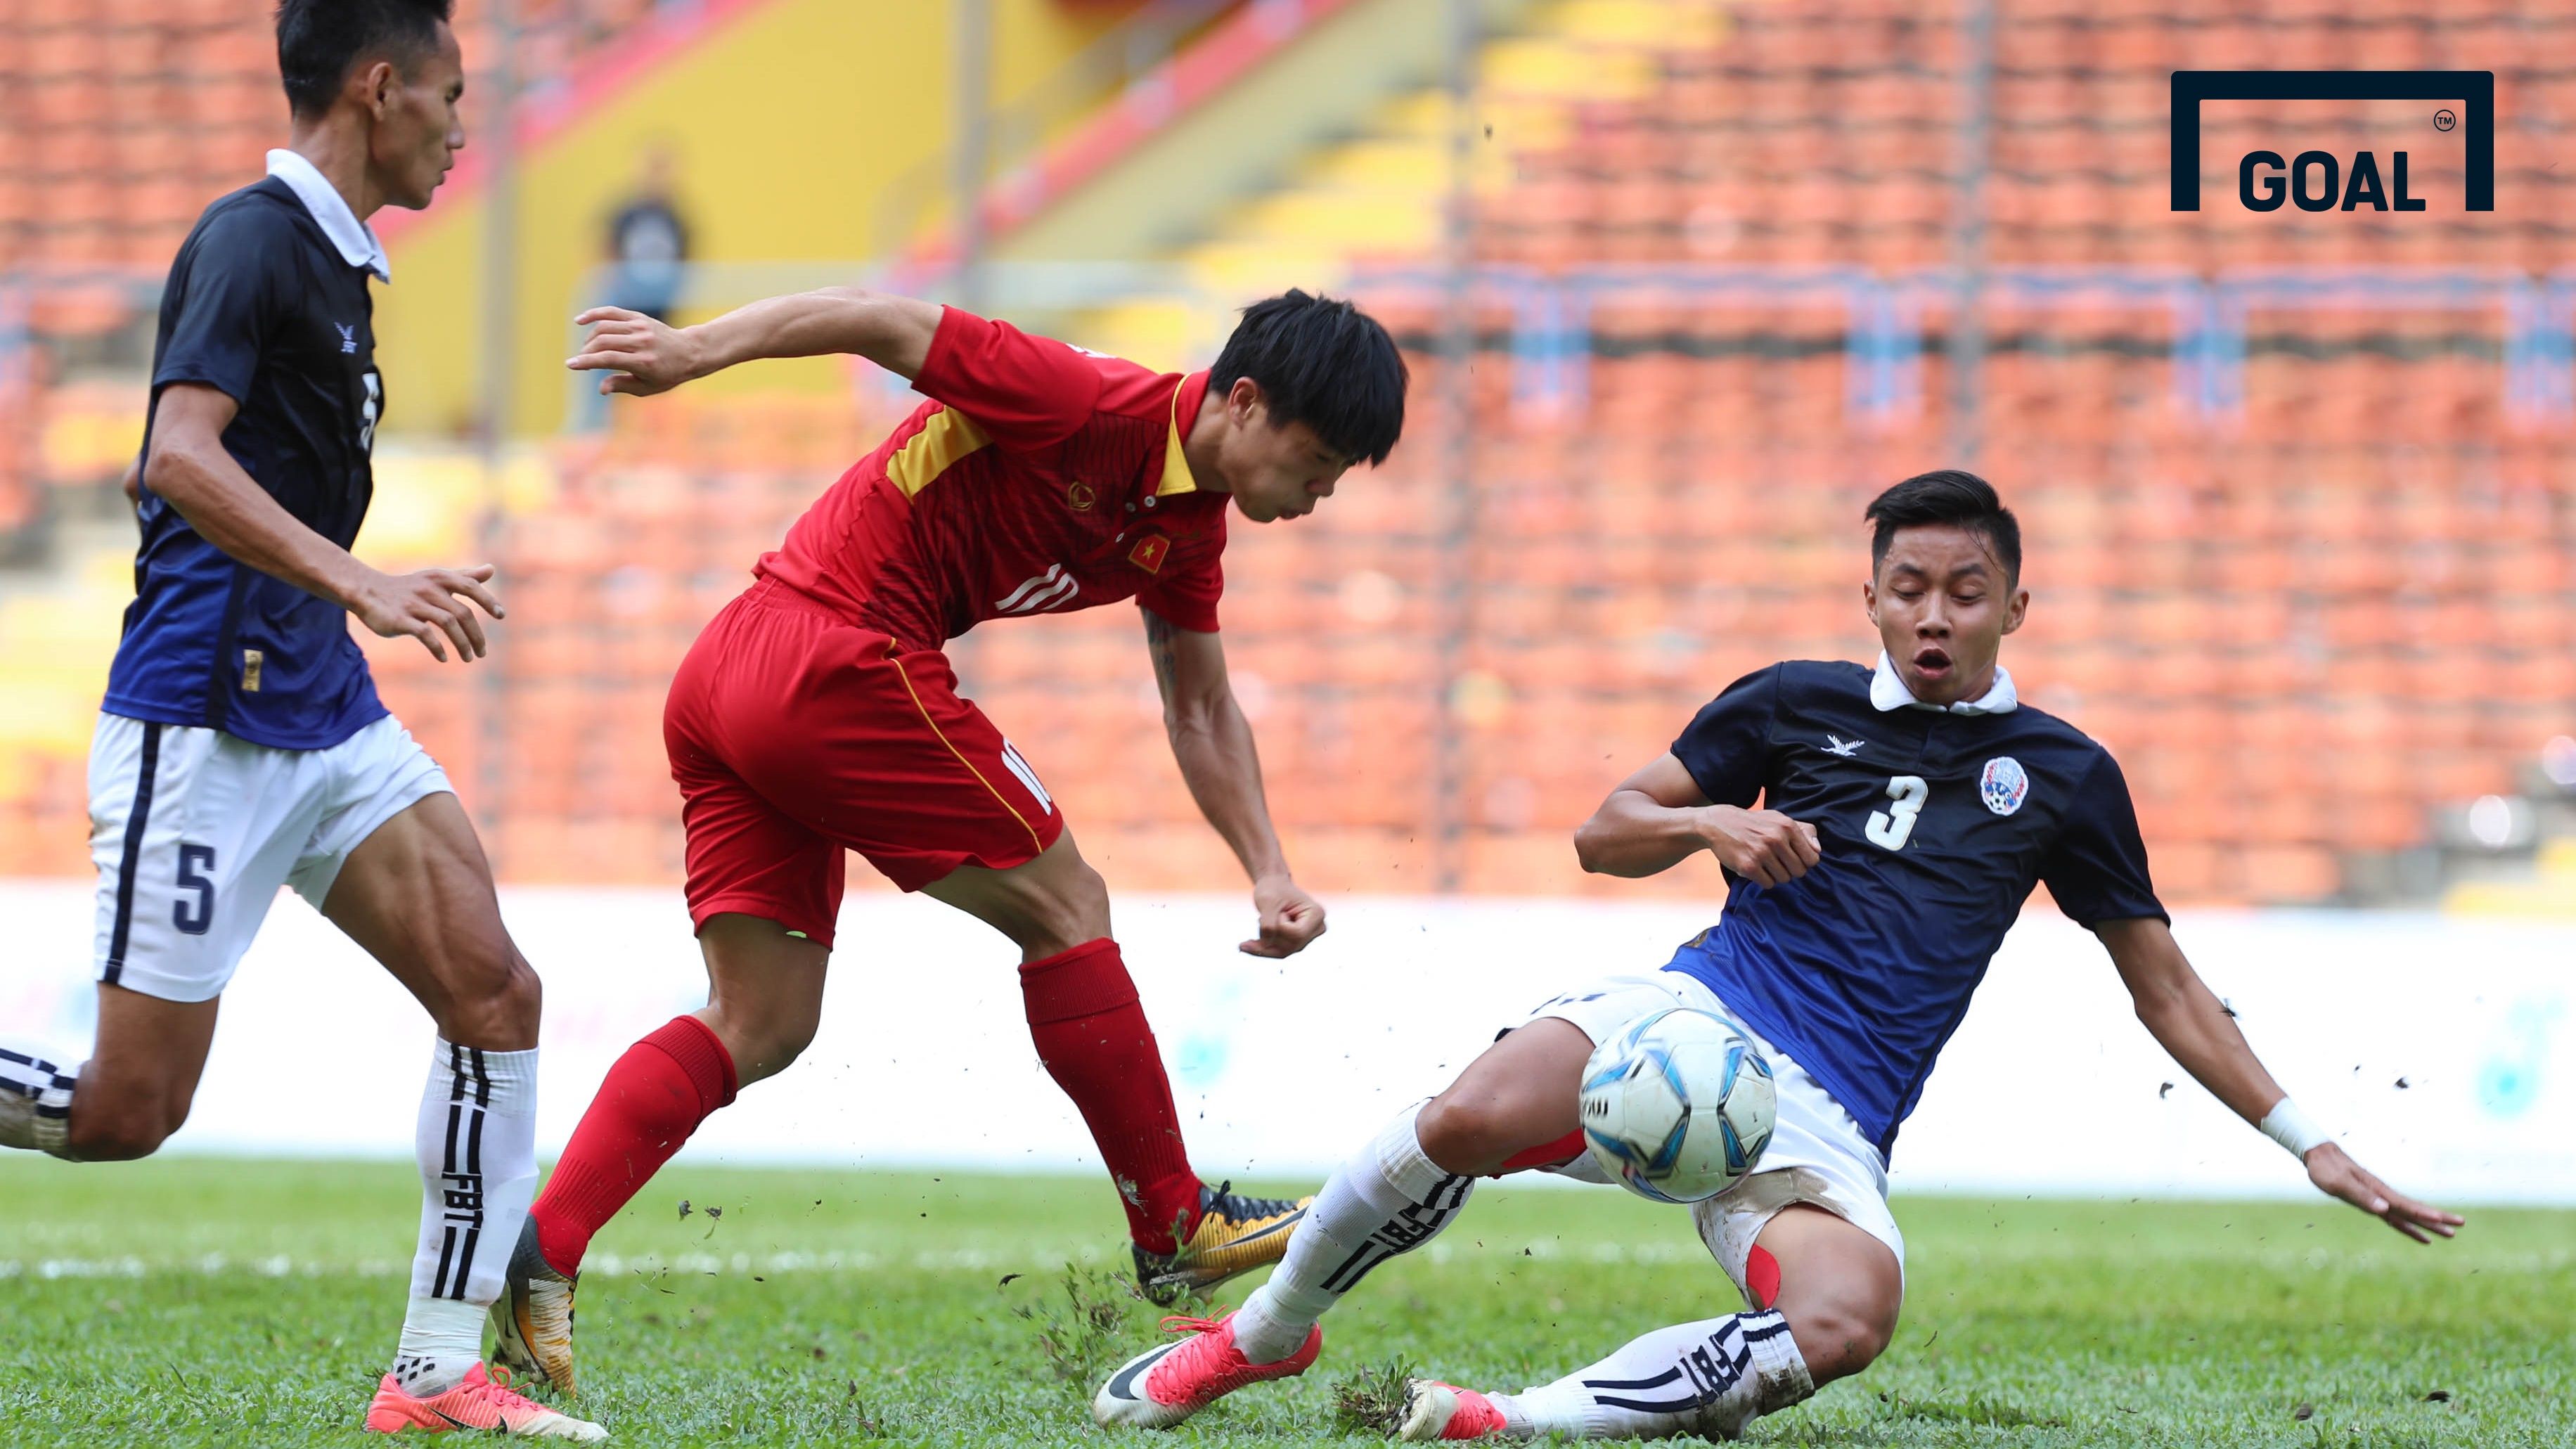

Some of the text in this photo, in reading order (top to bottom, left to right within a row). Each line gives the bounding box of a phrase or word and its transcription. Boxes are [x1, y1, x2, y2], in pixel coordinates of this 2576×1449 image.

[1865, 775, 1928, 851] 3
[172, 843, 216, 935] 5
[441, 1173, 484, 1230] FBT
[1680, 1334, 1741, 1405] FBT
